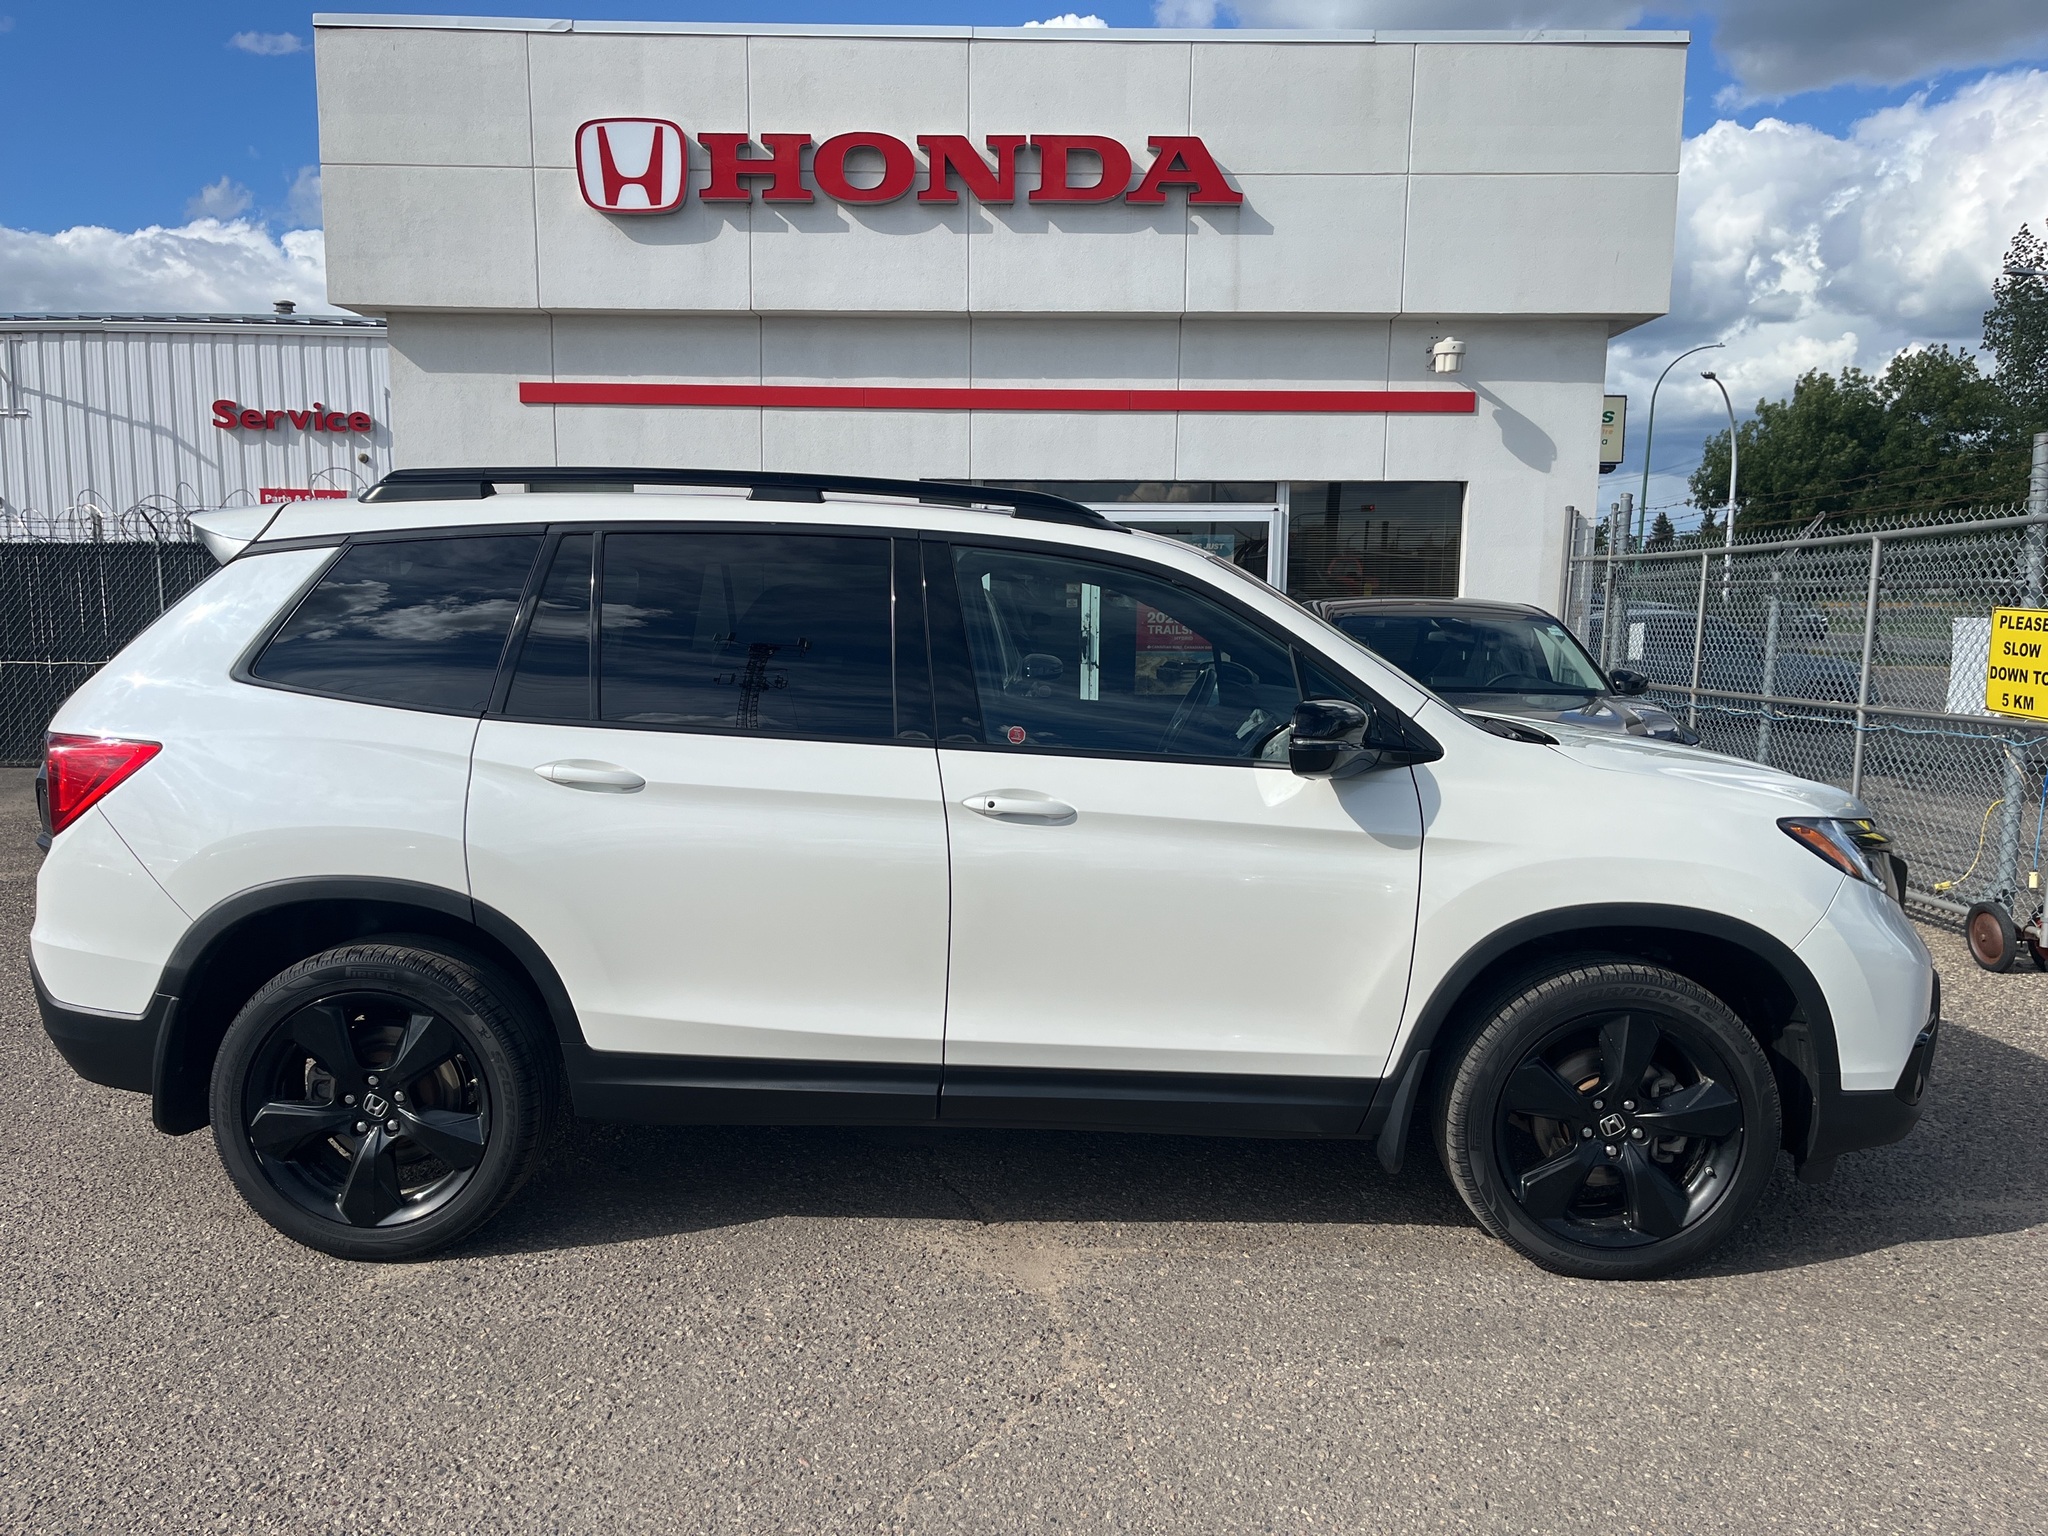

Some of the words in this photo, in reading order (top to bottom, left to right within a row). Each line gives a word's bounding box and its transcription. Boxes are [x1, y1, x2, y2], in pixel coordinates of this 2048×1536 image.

[697, 131, 1245, 207] HONDA
[212, 400, 372, 432] Service
[1147, 611, 1181, 624] 202
[2000, 615, 2048, 632] PLEASE
[1147, 624, 1193, 635] TRAILS
[2003, 641, 2041, 658] SLOW
[1990, 666, 2028, 683] DOWN
[2033, 670, 2048, 686] TO
[2001, 693, 2009, 707] 5
[2013, 694, 2034, 711] KM
